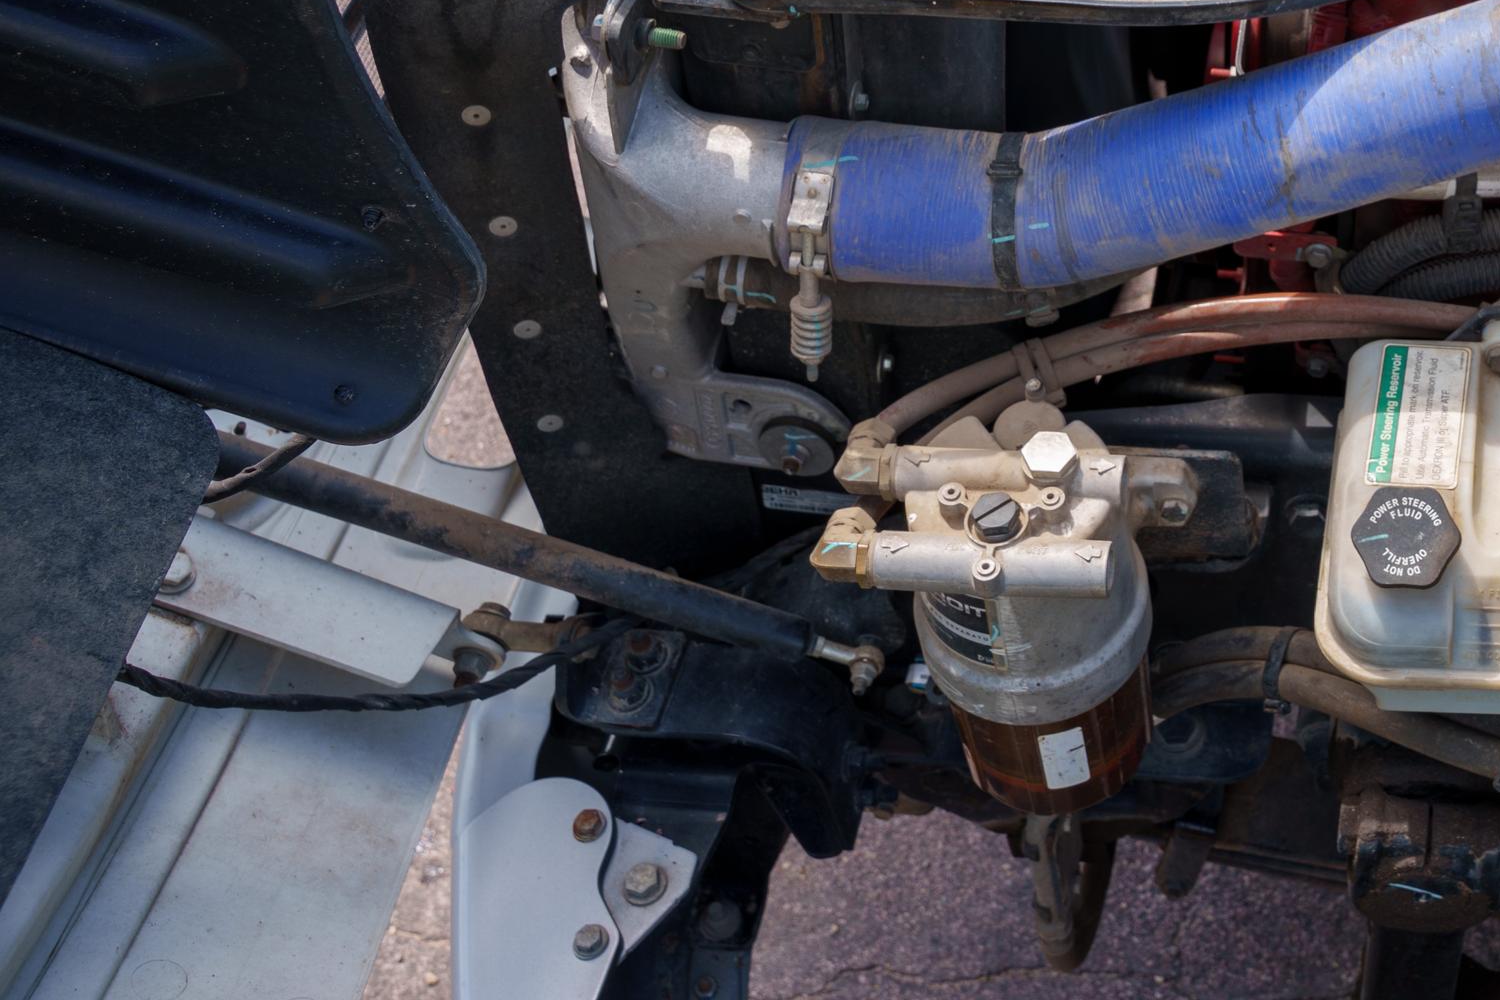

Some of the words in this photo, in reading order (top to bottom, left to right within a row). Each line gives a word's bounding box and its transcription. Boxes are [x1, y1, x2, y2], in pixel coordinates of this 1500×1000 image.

[1385, 352, 1403, 398] Reservoir
[1427, 357, 1438, 375] Fluid
[1410, 383, 1419, 393] on
[1406, 395, 1418, 412] mark
[1422, 376, 1436, 422] Transmission
[1379, 400, 1398, 440] Steering
[1417, 424, 1430, 461] Automatic
[1375, 442, 1390, 472] Power
[1369, 497, 1400, 524] POWER
[1401, 496, 1442, 528] STEERING
[1390, 509, 1423, 521] FLUID
[1381, 547, 1428, 567] OVERFILL
[1383, 564, 1404, 577] NOT
[1406, 565, 1421, 576] DO
